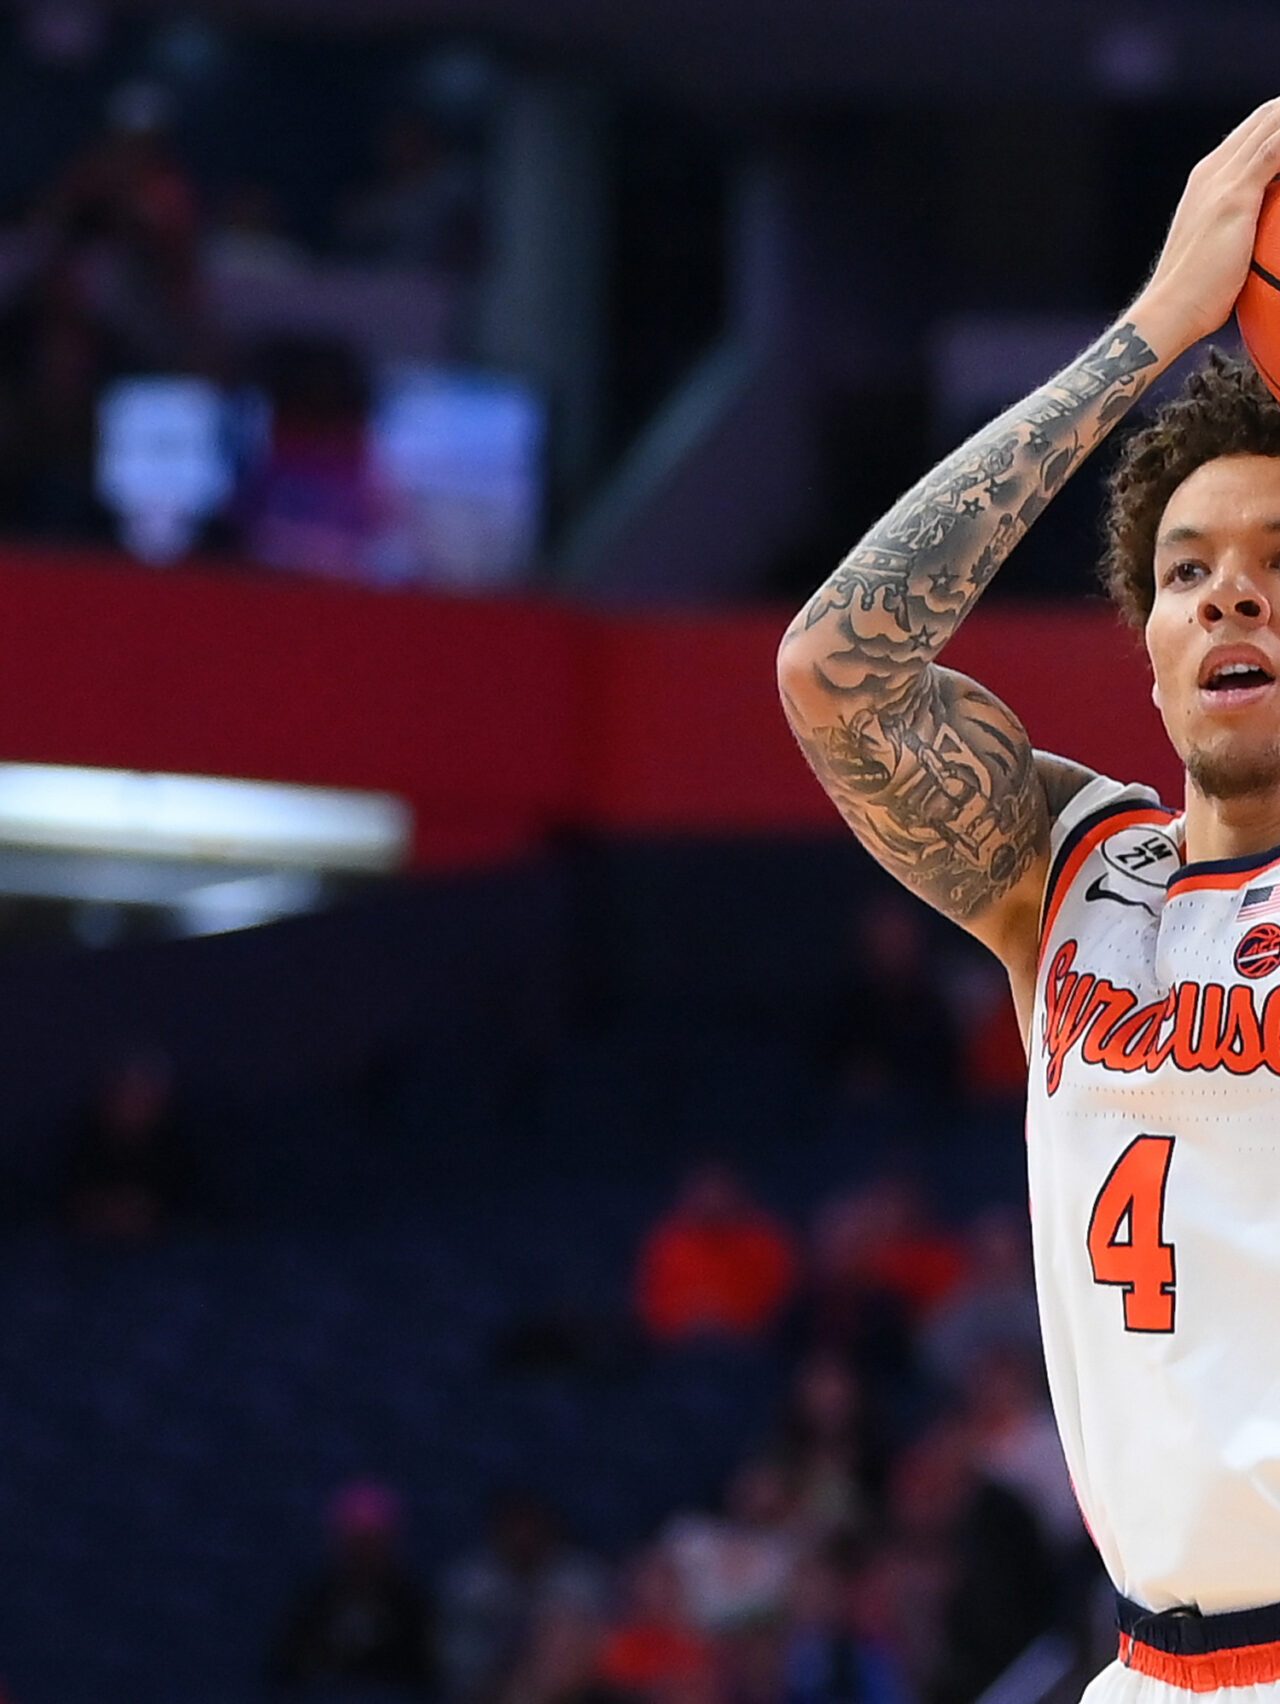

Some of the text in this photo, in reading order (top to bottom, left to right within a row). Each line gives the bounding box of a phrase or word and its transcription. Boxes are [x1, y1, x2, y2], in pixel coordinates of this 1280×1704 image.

[1115, 846, 1156, 871] 21
[1141, 836, 1173, 861] LM
[1086, 1134, 1176, 1334] 4
